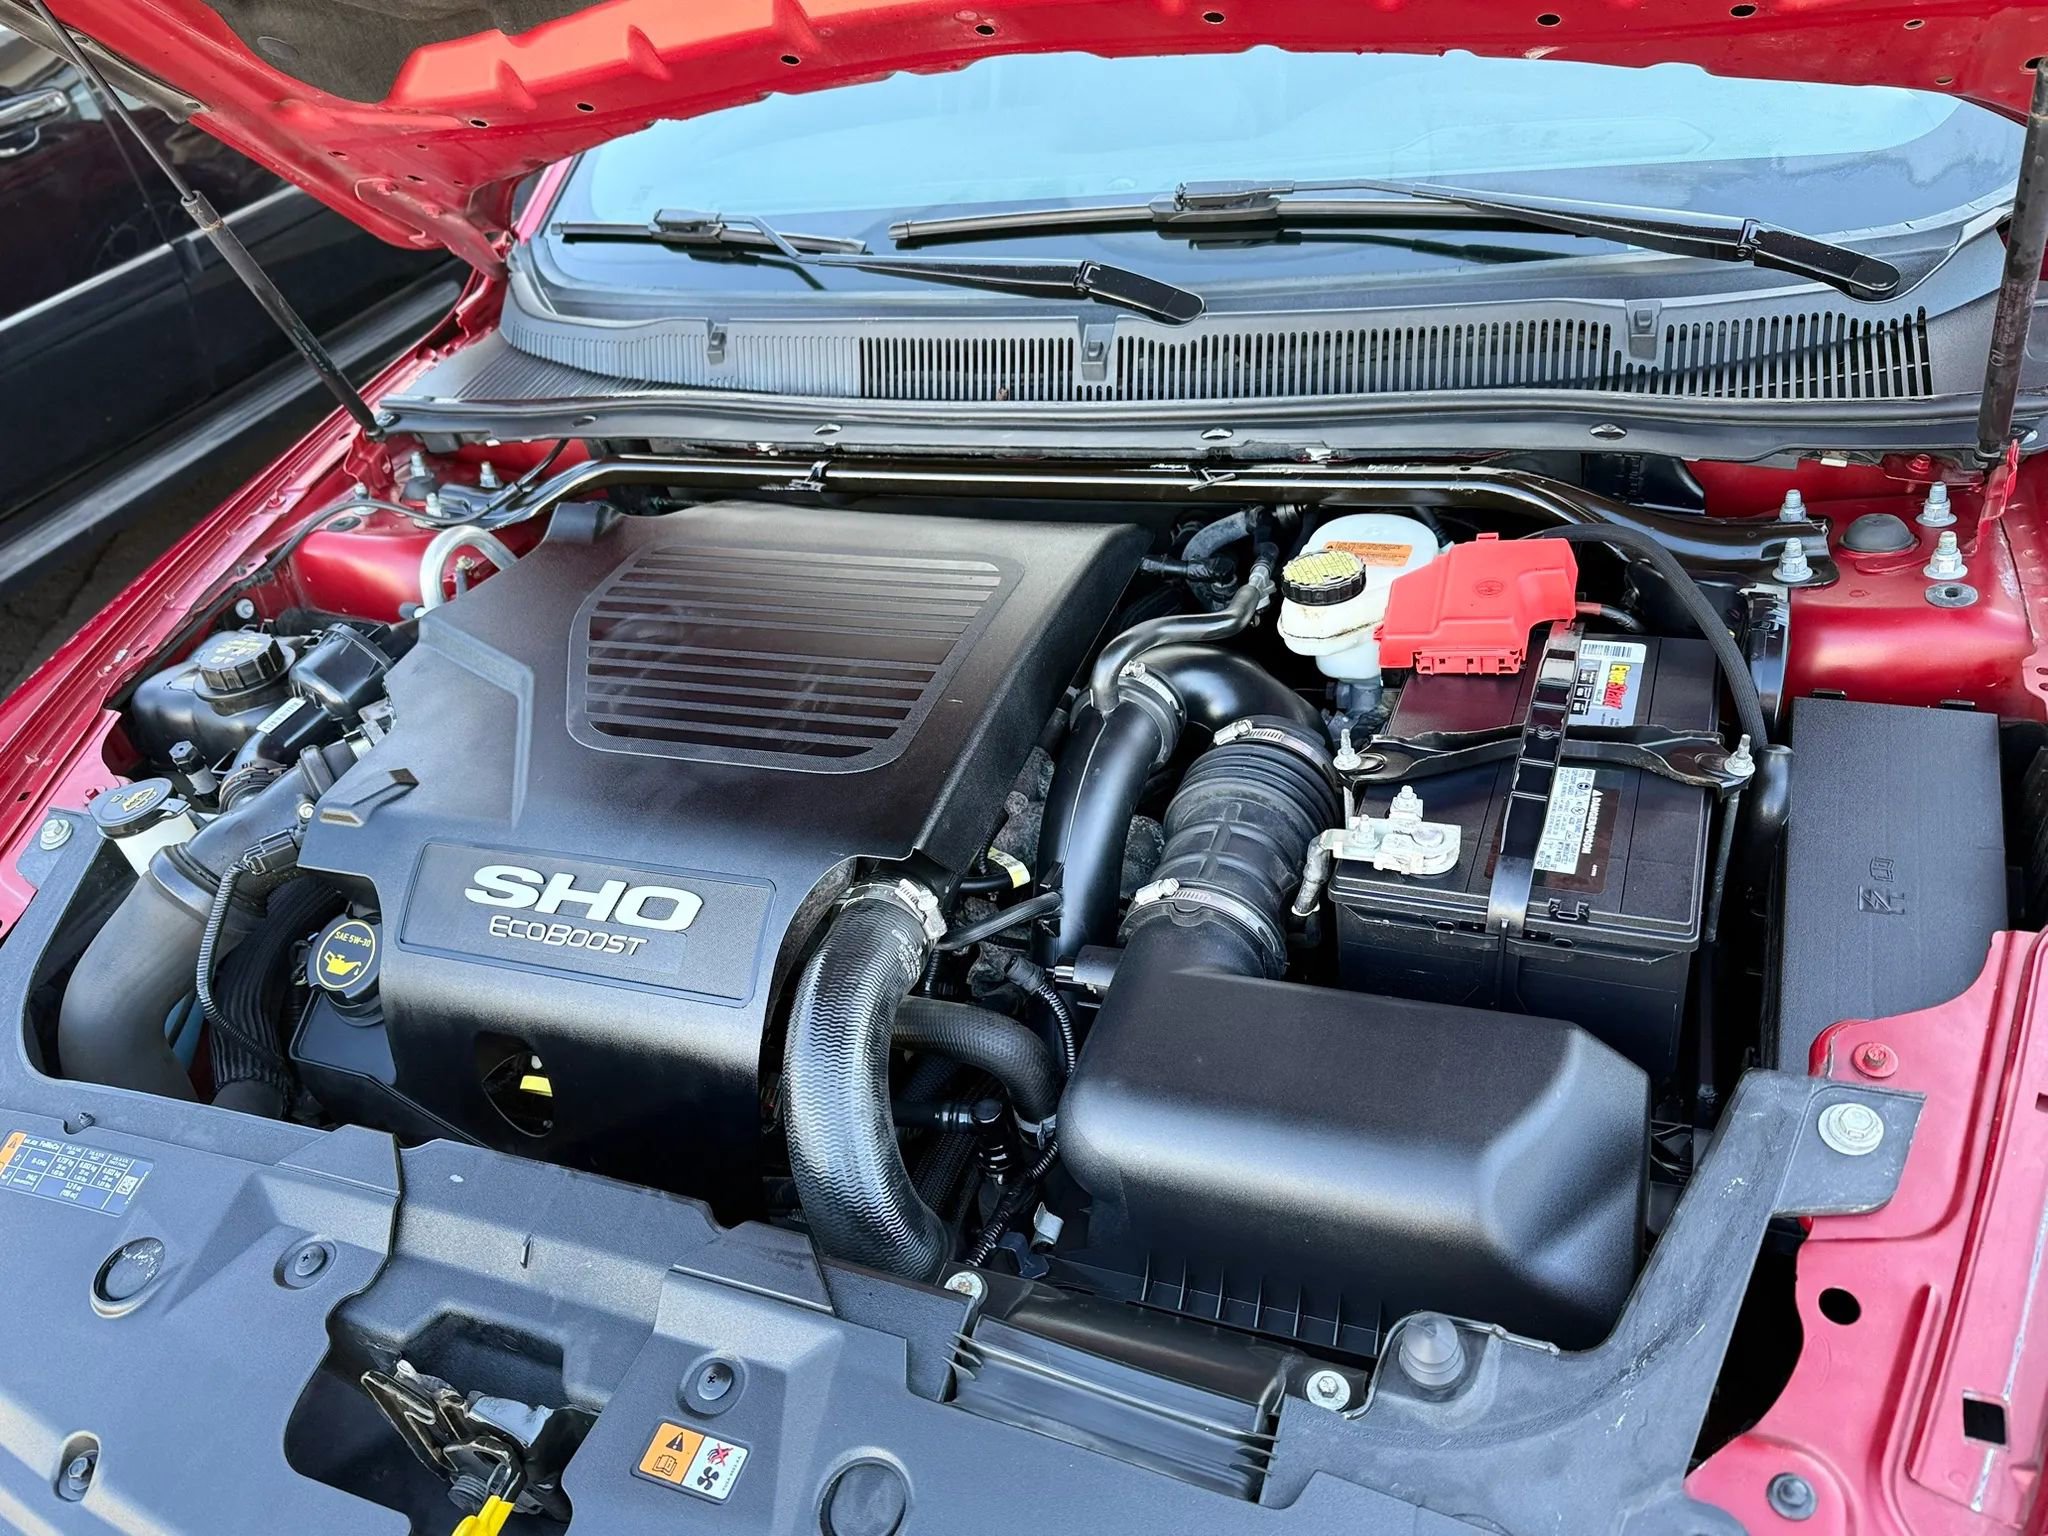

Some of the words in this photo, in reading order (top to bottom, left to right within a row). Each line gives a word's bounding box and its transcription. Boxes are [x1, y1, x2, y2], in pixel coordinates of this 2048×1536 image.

[1602, 664, 1631, 709] EverStart
[464, 864, 704, 932] SHO
[334, 931, 350, 942] SAE
[348, 934, 372, 948] 5W-30
